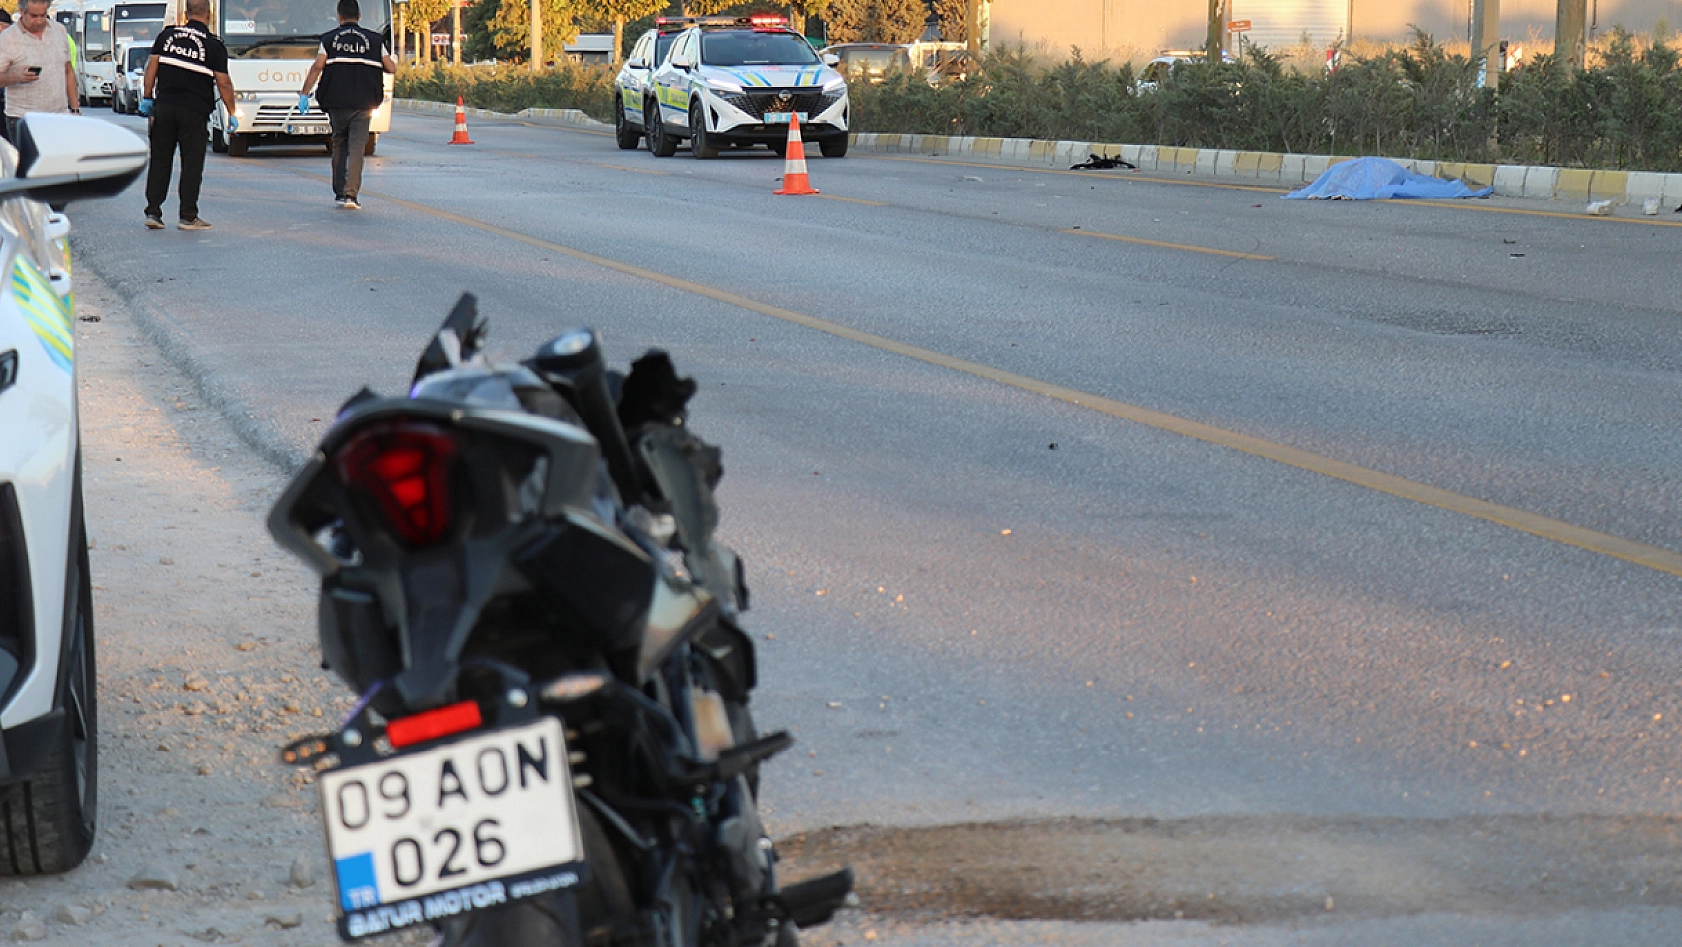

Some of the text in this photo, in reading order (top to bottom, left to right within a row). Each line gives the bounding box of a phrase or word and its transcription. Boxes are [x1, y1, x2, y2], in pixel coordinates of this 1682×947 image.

[339, 735, 550, 831] 09 AON
[391, 818, 506, 888] 026
[347, 886, 377, 909] TR
[424, 880, 507, 920] MOTOR
